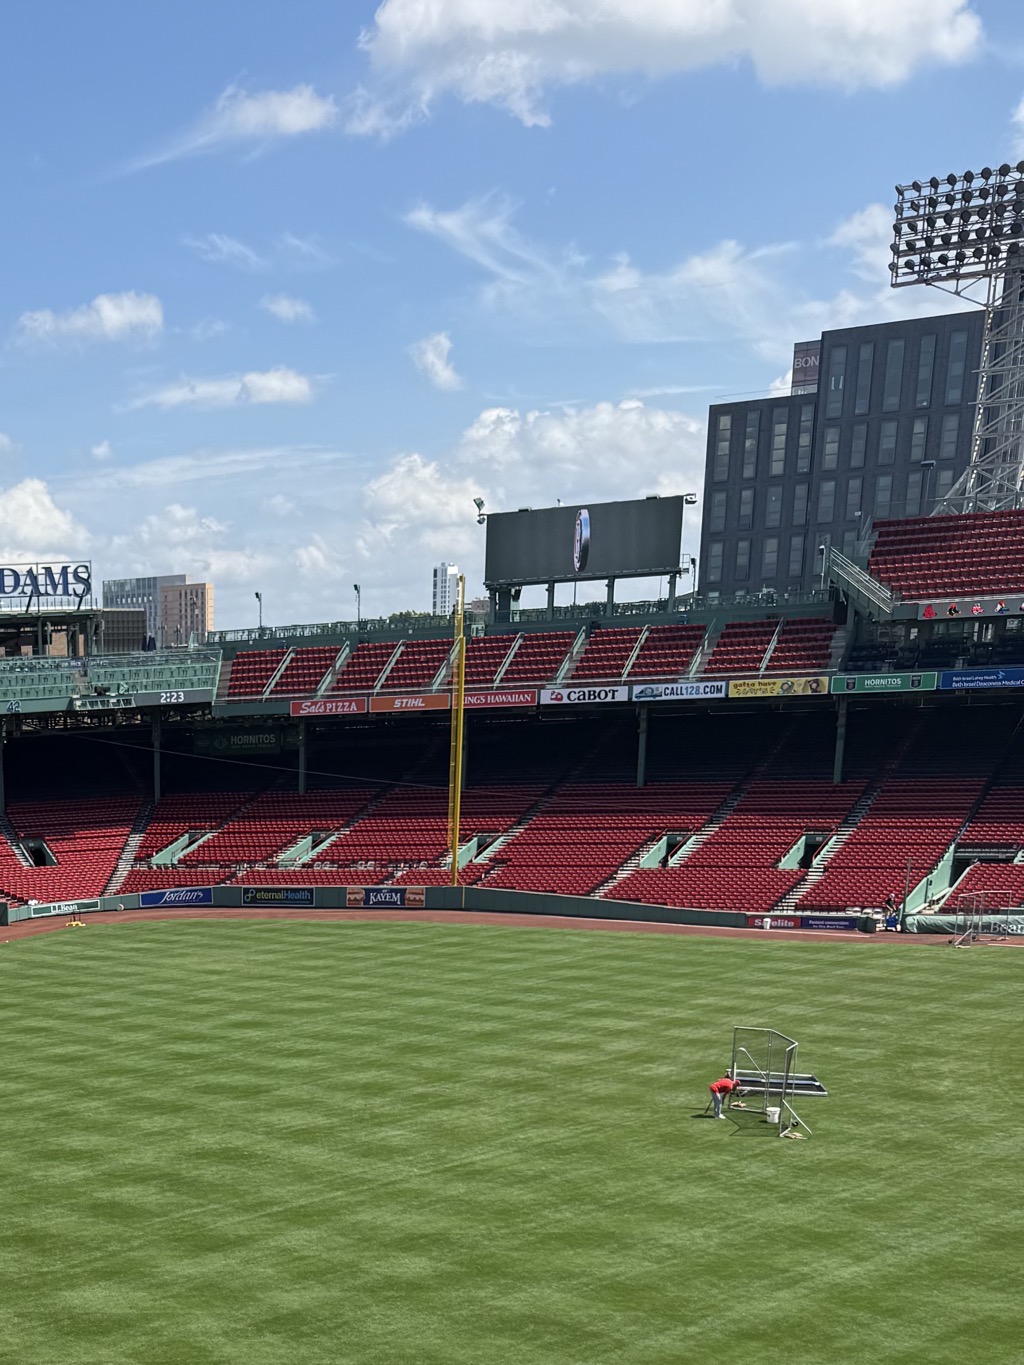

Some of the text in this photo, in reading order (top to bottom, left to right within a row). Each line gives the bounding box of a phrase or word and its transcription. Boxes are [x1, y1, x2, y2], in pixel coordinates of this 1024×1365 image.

[864, 678, 902, 686] HORNITOS
[663, 684, 723, 697] CALL128.COM
[159, 692, 185, 703] 2:23
[393, 698, 426, 708] STIHL
[462, 693, 532, 704] ING'S HAWAIIAN
[6, 699, 22, 713] 42
[299, 701, 357, 714] Sal's PIZZA
[230, 734, 276, 745] HORNITOS
[159, 889, 204, 904] Jordan's
[256, 889, 311, 899] eternalHealth
[369, 892, 401, 904] KAYEM
[754, 919, 795, 928] Selite
